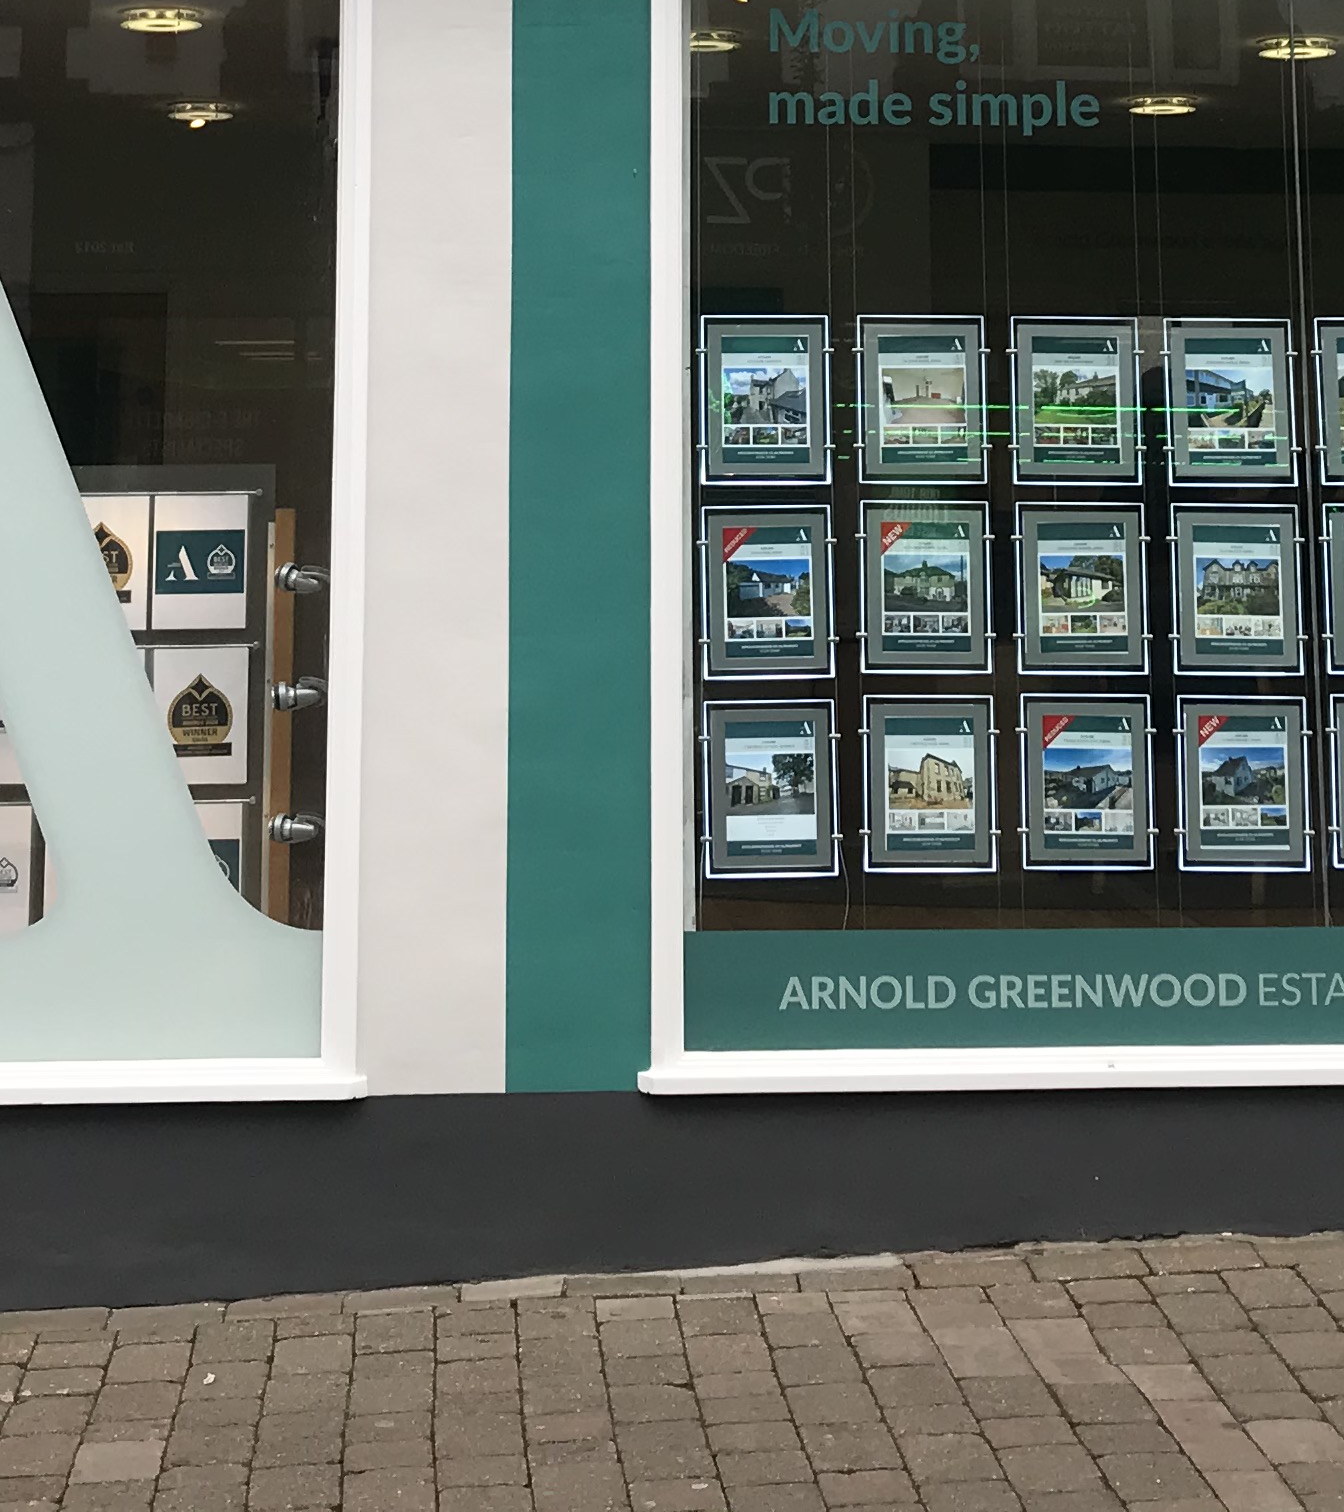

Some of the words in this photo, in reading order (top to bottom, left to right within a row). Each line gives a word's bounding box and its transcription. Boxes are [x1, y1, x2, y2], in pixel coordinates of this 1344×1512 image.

[769, 7, 980, 64] Moving,
[769, 79, 912, 127] made
[929, 80, 1100, 137] simple
[882, 523, 903, 545] NEW
[103, 550, 119, 564] ST
[181, 703, 218, 716] BEST
[182, 728, 218, 737] WINNER
[1199, 715, 1220, 738] NEW
[779, 974, 956, 1011] ARNOLD
[967, 973, 1247, 1010] GREENWOOD
